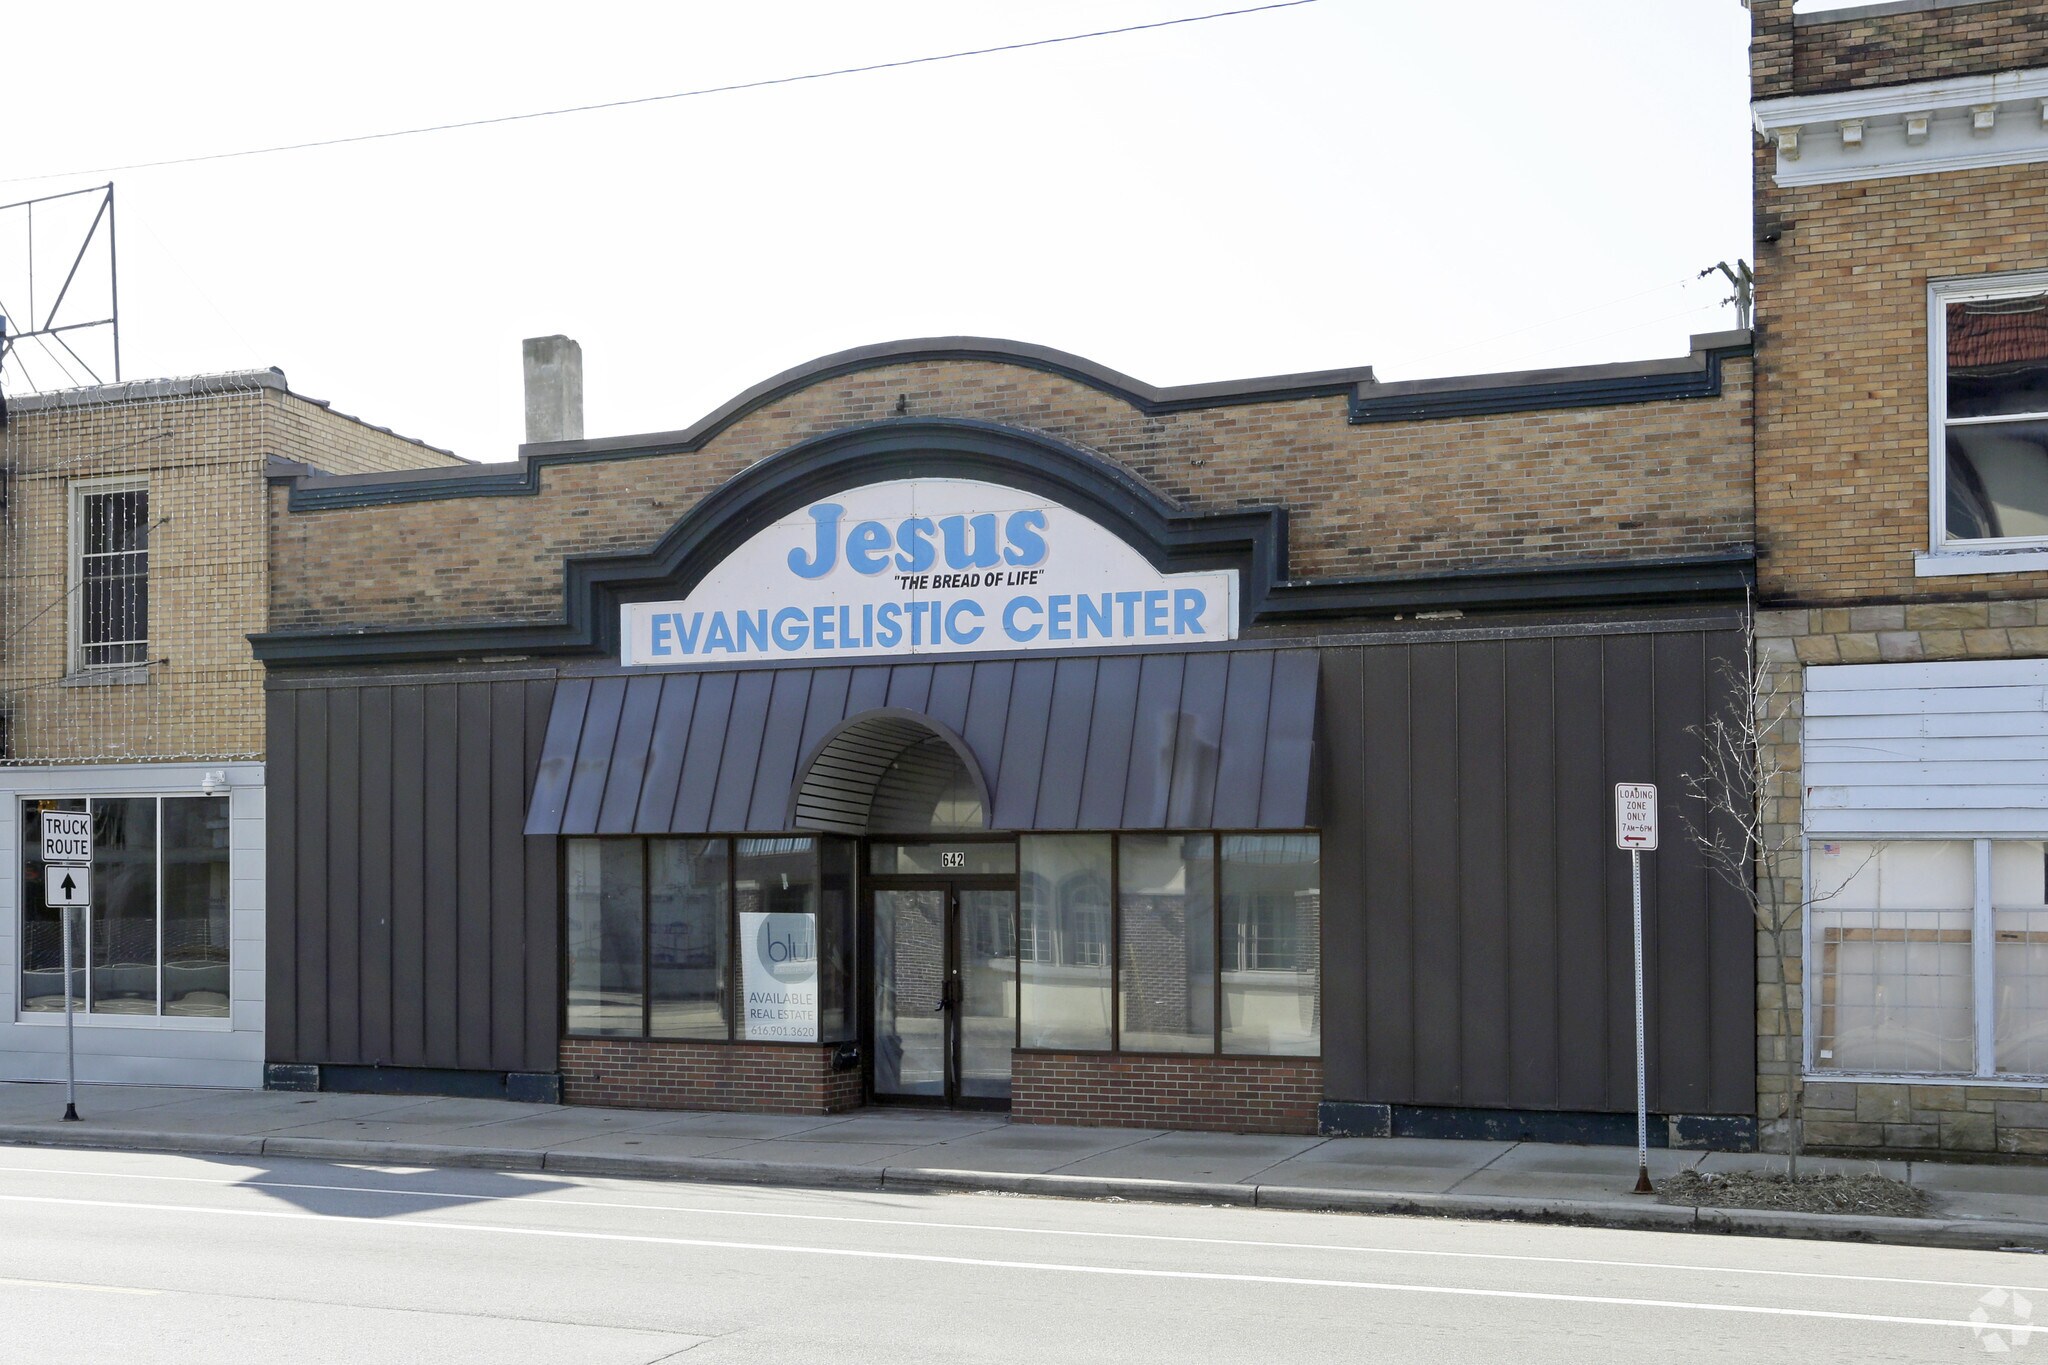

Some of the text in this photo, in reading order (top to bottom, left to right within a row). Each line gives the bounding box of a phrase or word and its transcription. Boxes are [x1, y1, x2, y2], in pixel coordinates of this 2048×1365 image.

[787, 503, 1049, 579] Jesus
[894, 569, 1045, 590] "THE BREAD OF LIFE"
[651, 588, 1207, 656] EVANGELISTIC CENTER
[1620, 790, 1653, 799] LOADING
[1627, 801, 1646, 810] ZONE
[1627, 812, 1646, 821] ONLY
[46, 819, 88, 835] TRUCK
[46, 839, 88, 854] ROUTE
[943, 853, 963, 867] 642
[767, 921, 809, 962] blu
[749, 992, 813, 1005] AVAILABLE
[750, 1008, 813, 1021] REAL ESTATE
[751, 1026, 815, 1037] 616.901.3620
